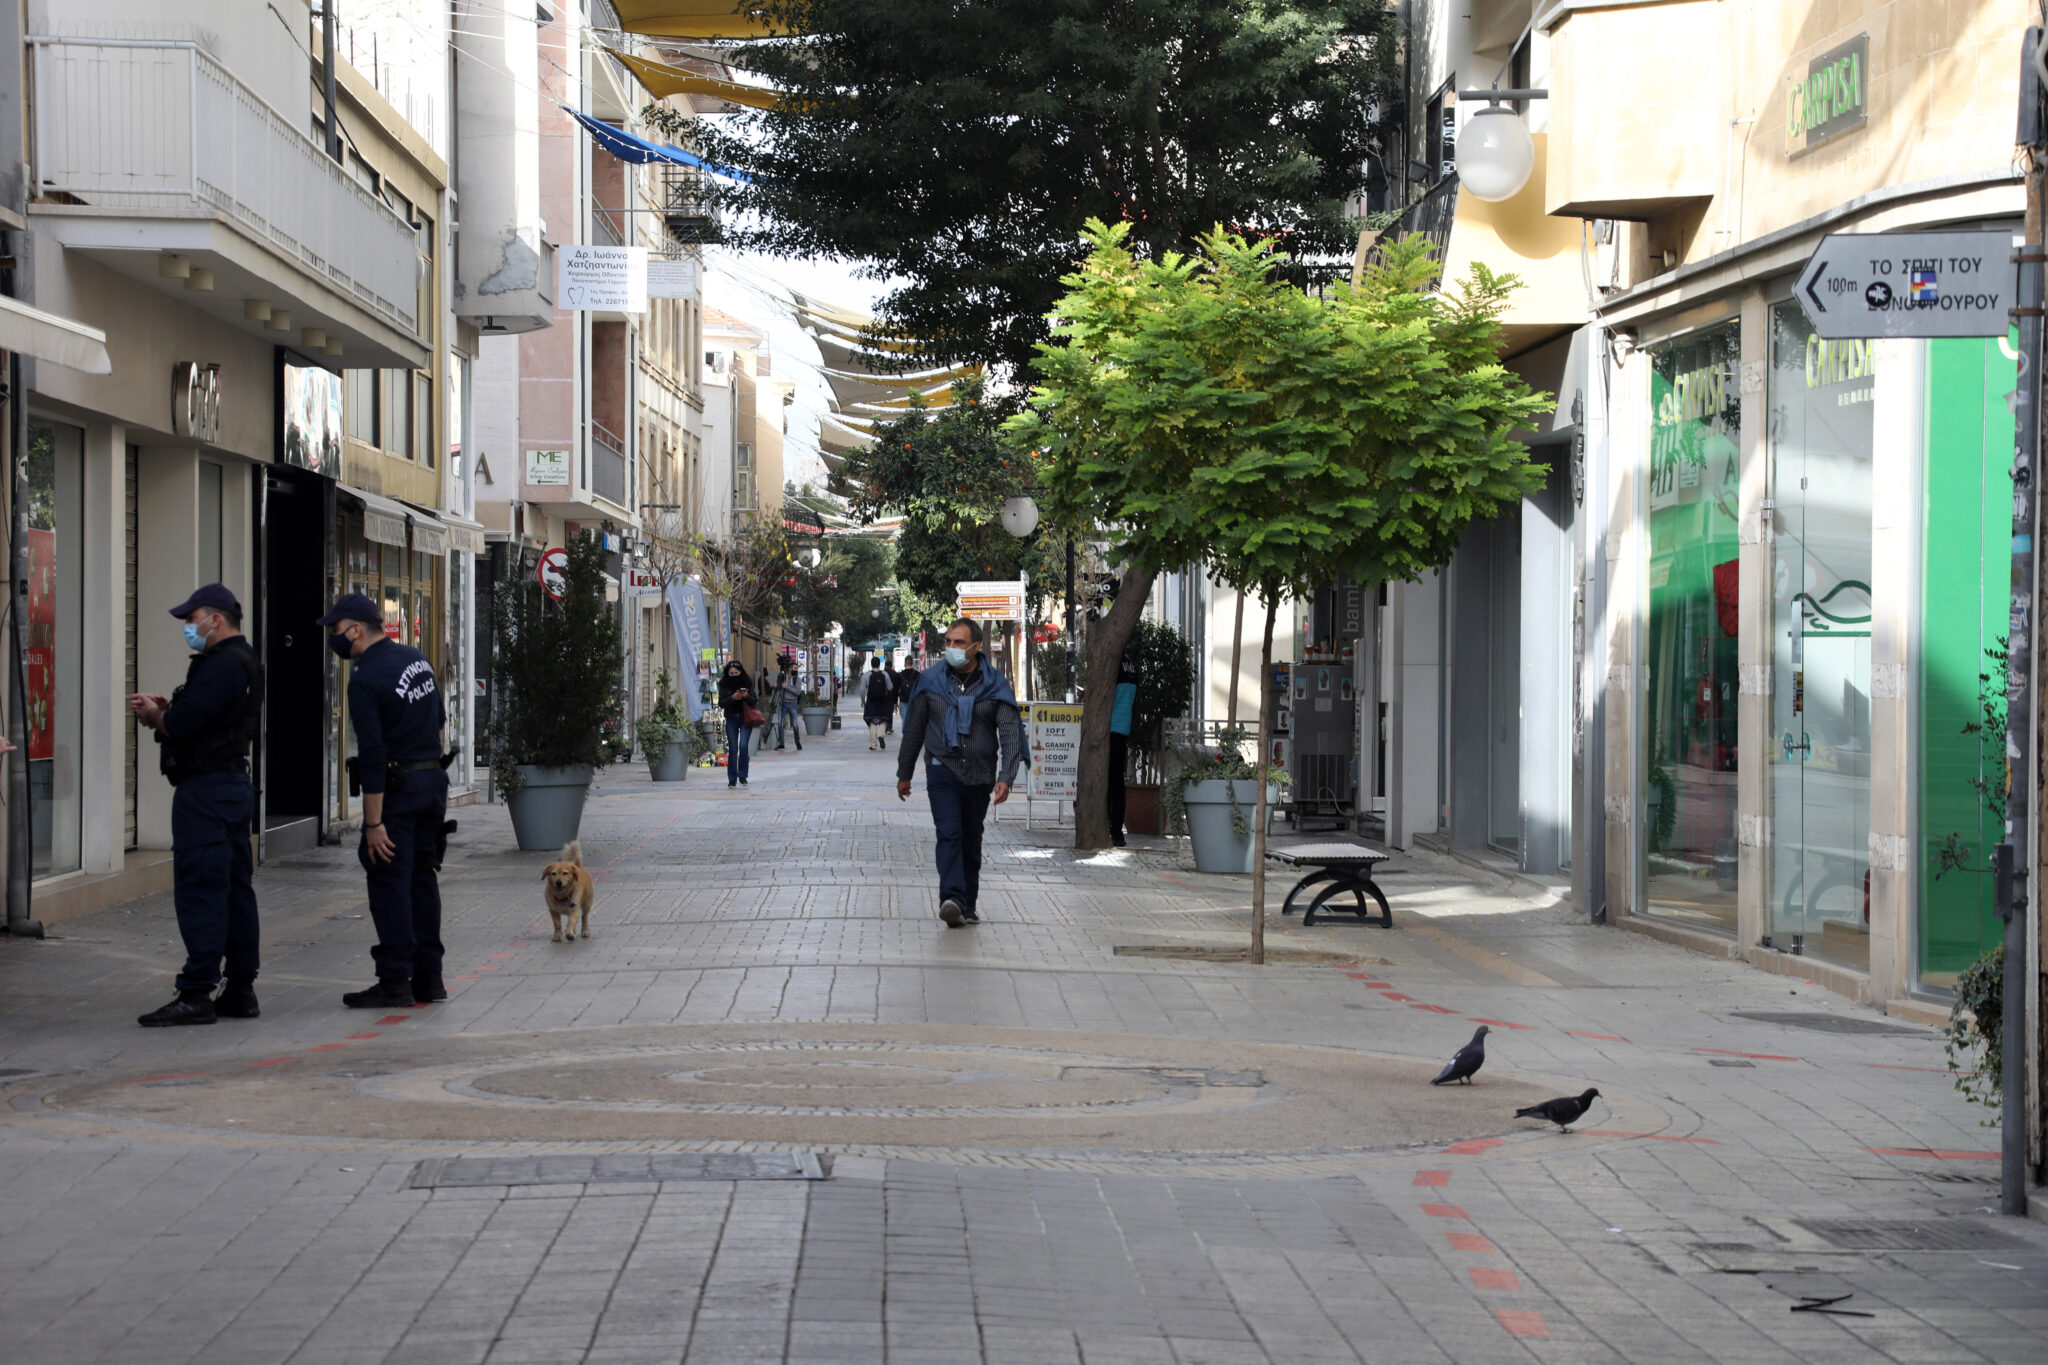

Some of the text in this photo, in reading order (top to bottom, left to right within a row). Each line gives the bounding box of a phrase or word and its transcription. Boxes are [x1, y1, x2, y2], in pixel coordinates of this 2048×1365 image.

[1788, 53, 1861, 137] CARPISA
[575, 250, 628, 260] Δρ. Ιωάννα
[1869, 259, 1892, 275] ΤΟ
[1949, 257, 1982, 274] ΤΟΥ
[1827, 278, 1858, 292] 100m
[1806, 333, 1875, 389] CARPISA
[1673, 362, 1728, 424] CARPISA
[536, 450, 562, 464] ME
[407, 677, 435, 704] POLICE
[1051, 713, 1072, 723] EURO
